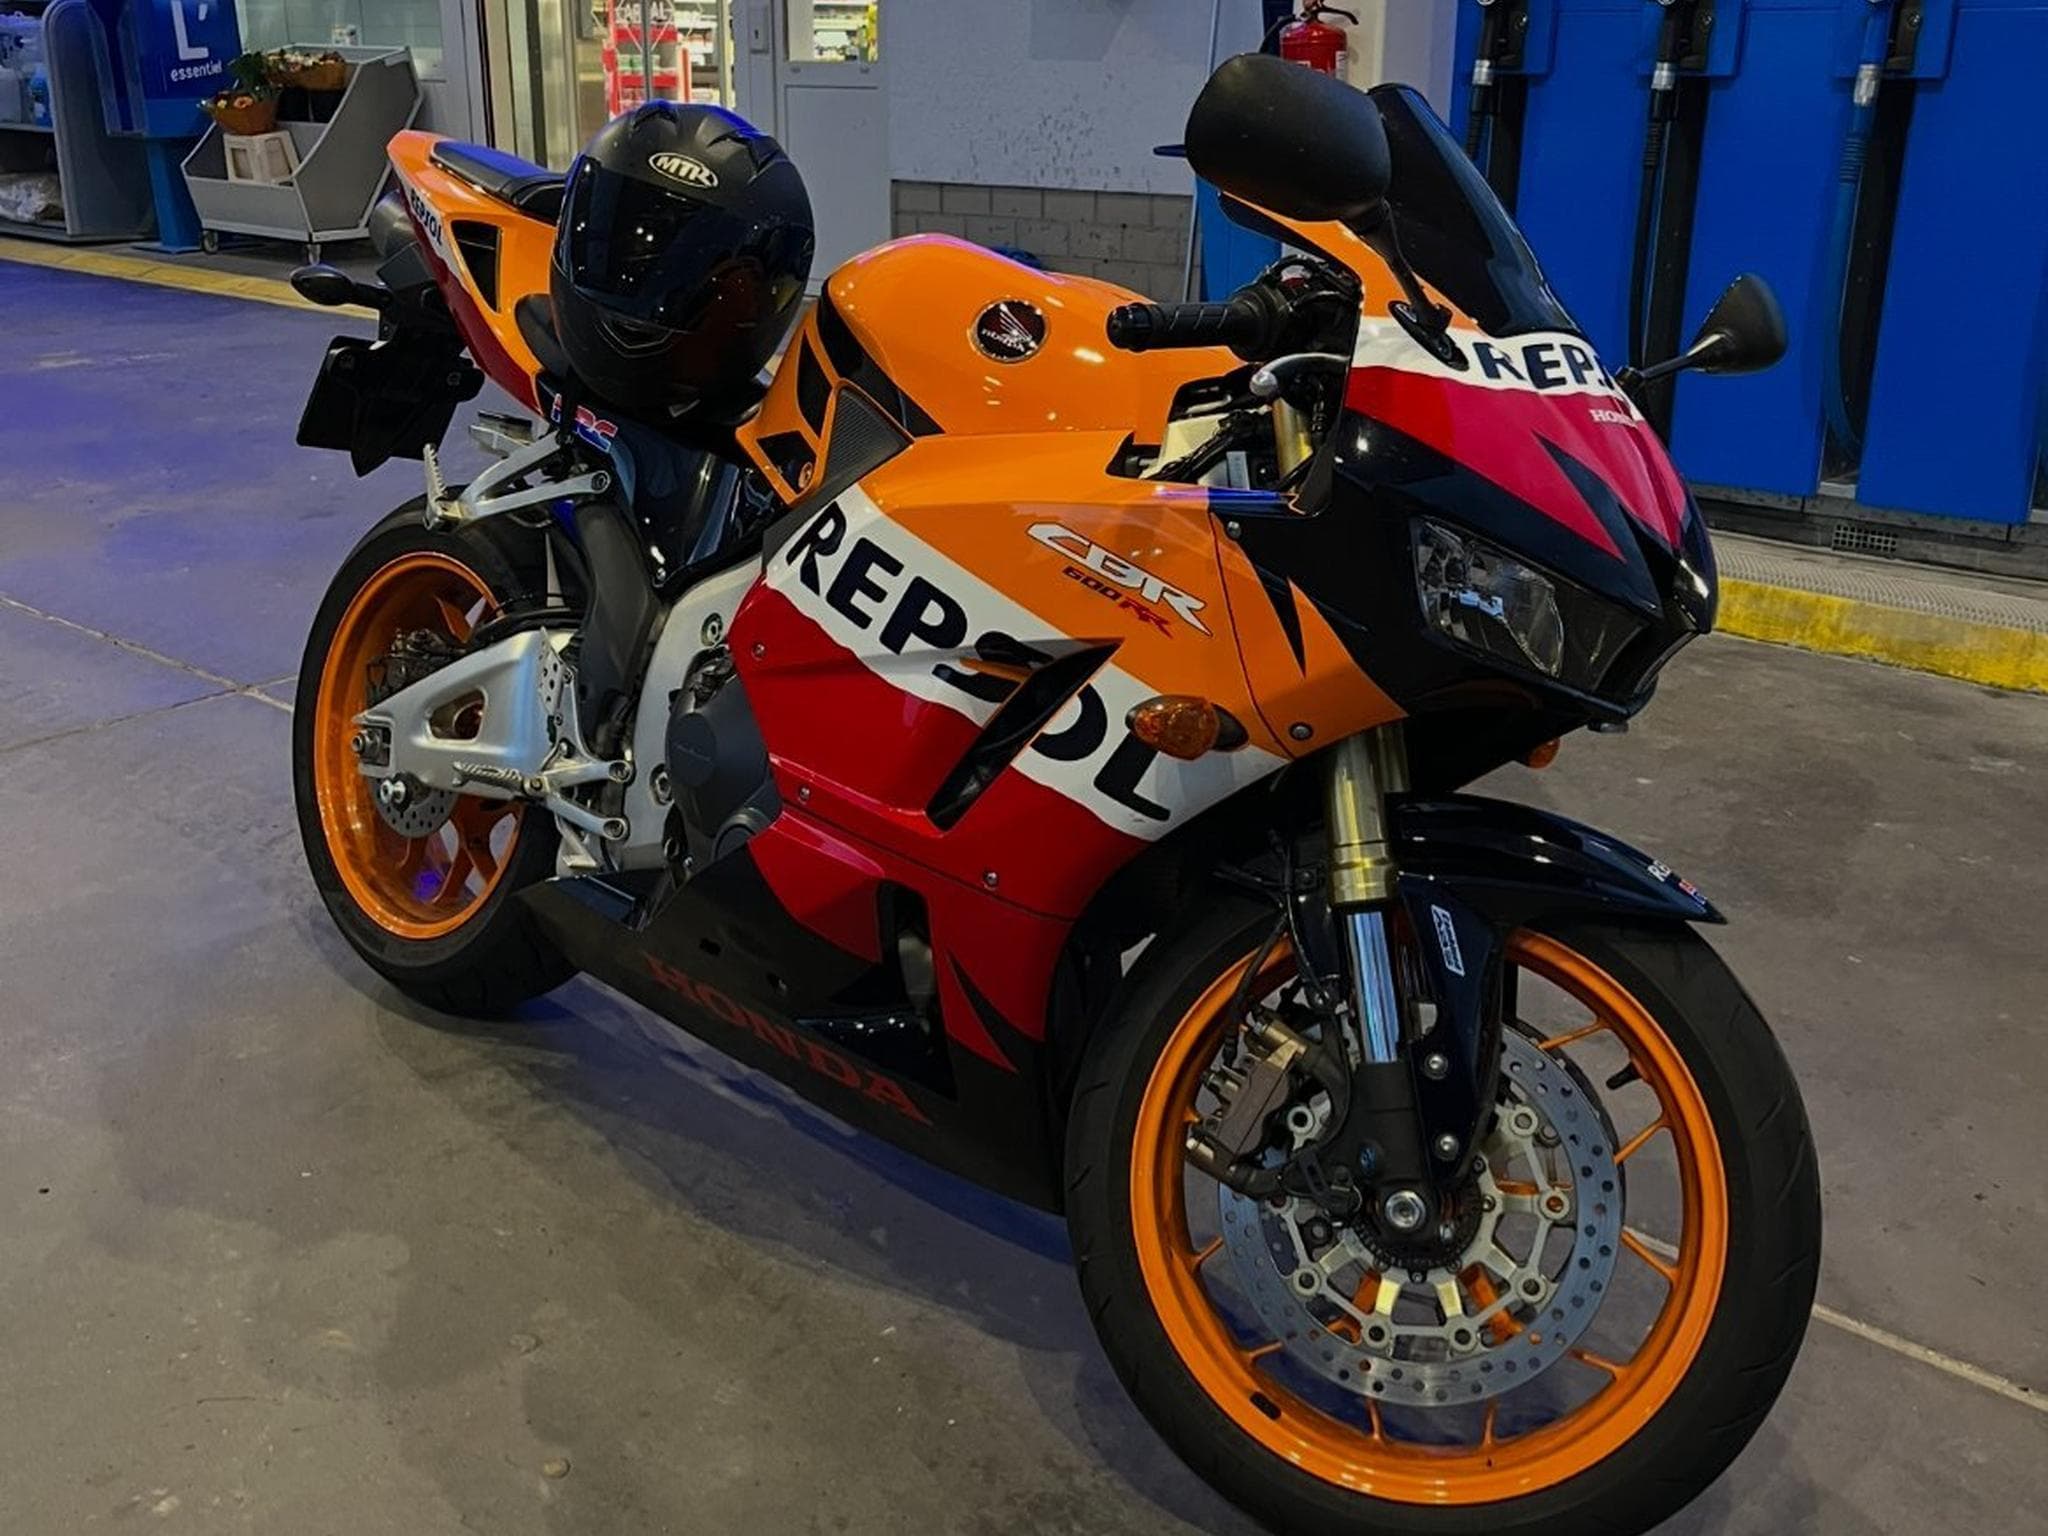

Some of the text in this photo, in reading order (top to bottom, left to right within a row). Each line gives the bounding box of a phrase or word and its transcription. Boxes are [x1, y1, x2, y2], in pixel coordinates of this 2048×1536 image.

[655, 156, 712, 187] MTR
[1026, 522, 1213, 637] CBR
[643, 951, 935, 1127] HONDA
